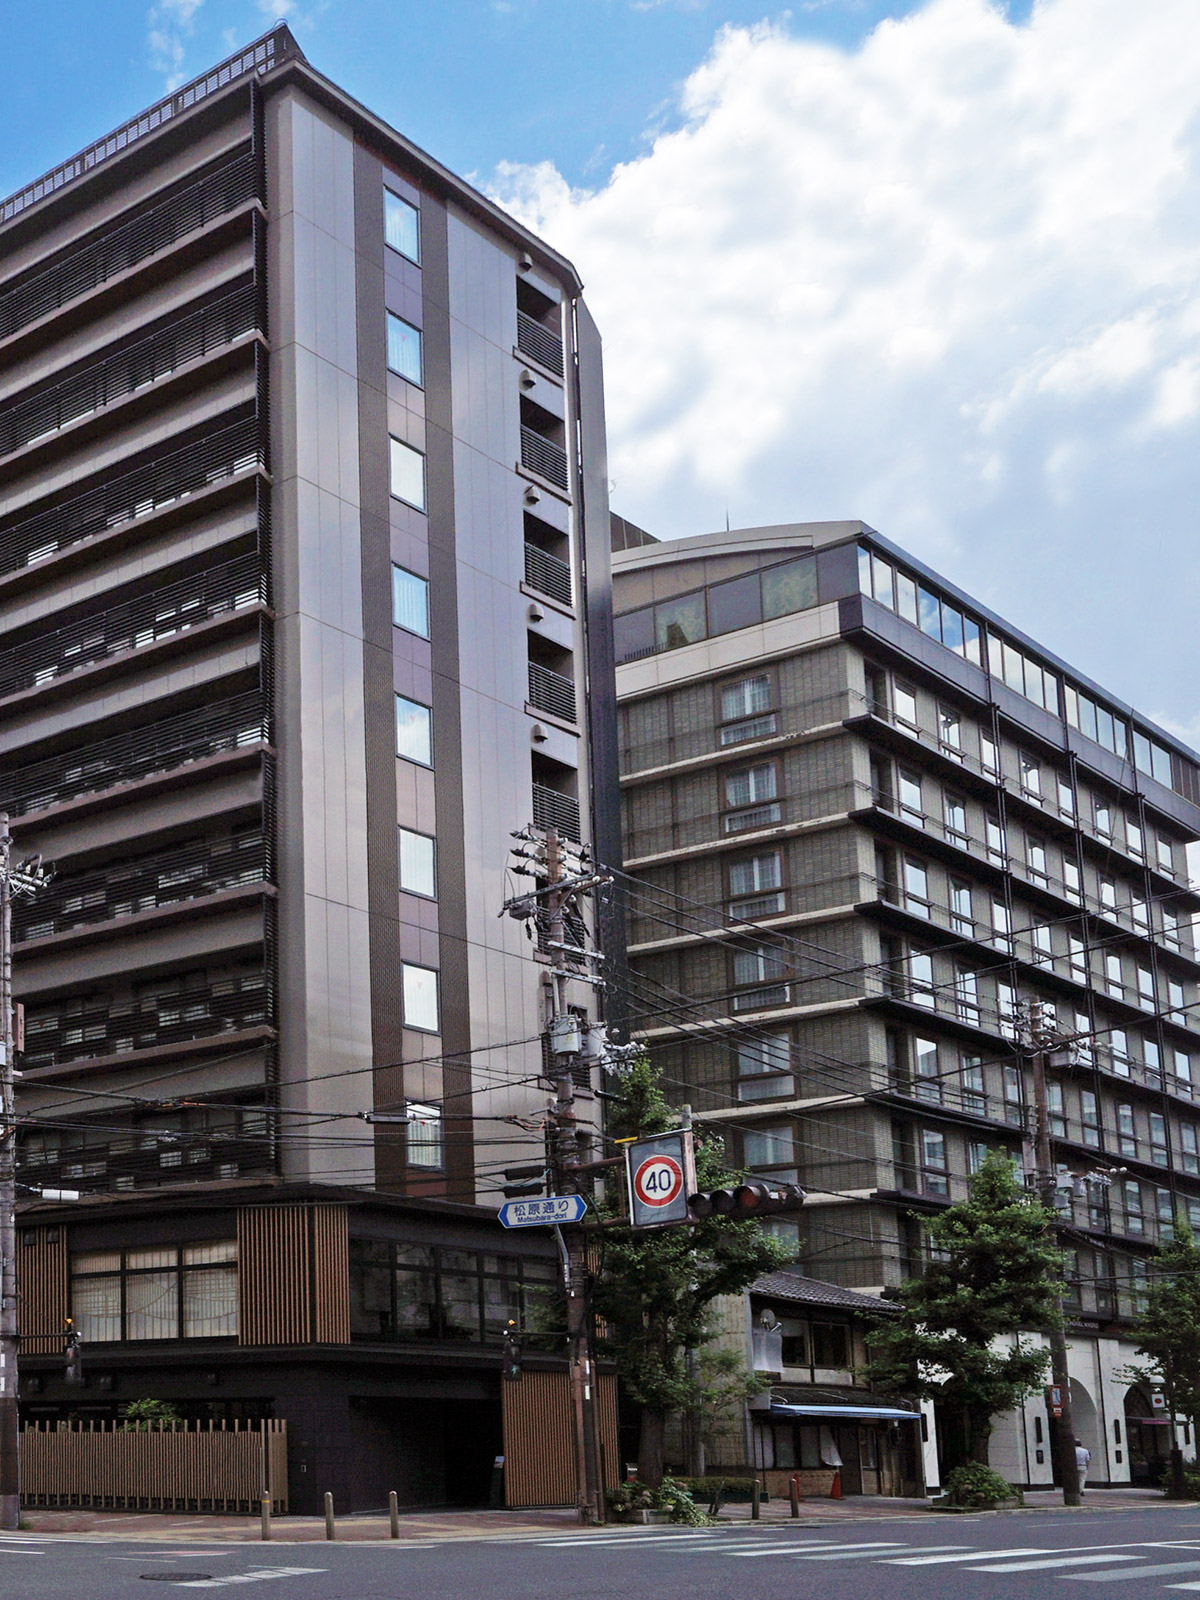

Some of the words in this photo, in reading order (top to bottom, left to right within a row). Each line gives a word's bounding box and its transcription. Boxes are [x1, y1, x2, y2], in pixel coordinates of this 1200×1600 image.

[645, 1169, 671, 1193] 40
[514, 1200, 569, 1217] 松原通り
[517, 1212, 567, 1223] Matsubara-dori
